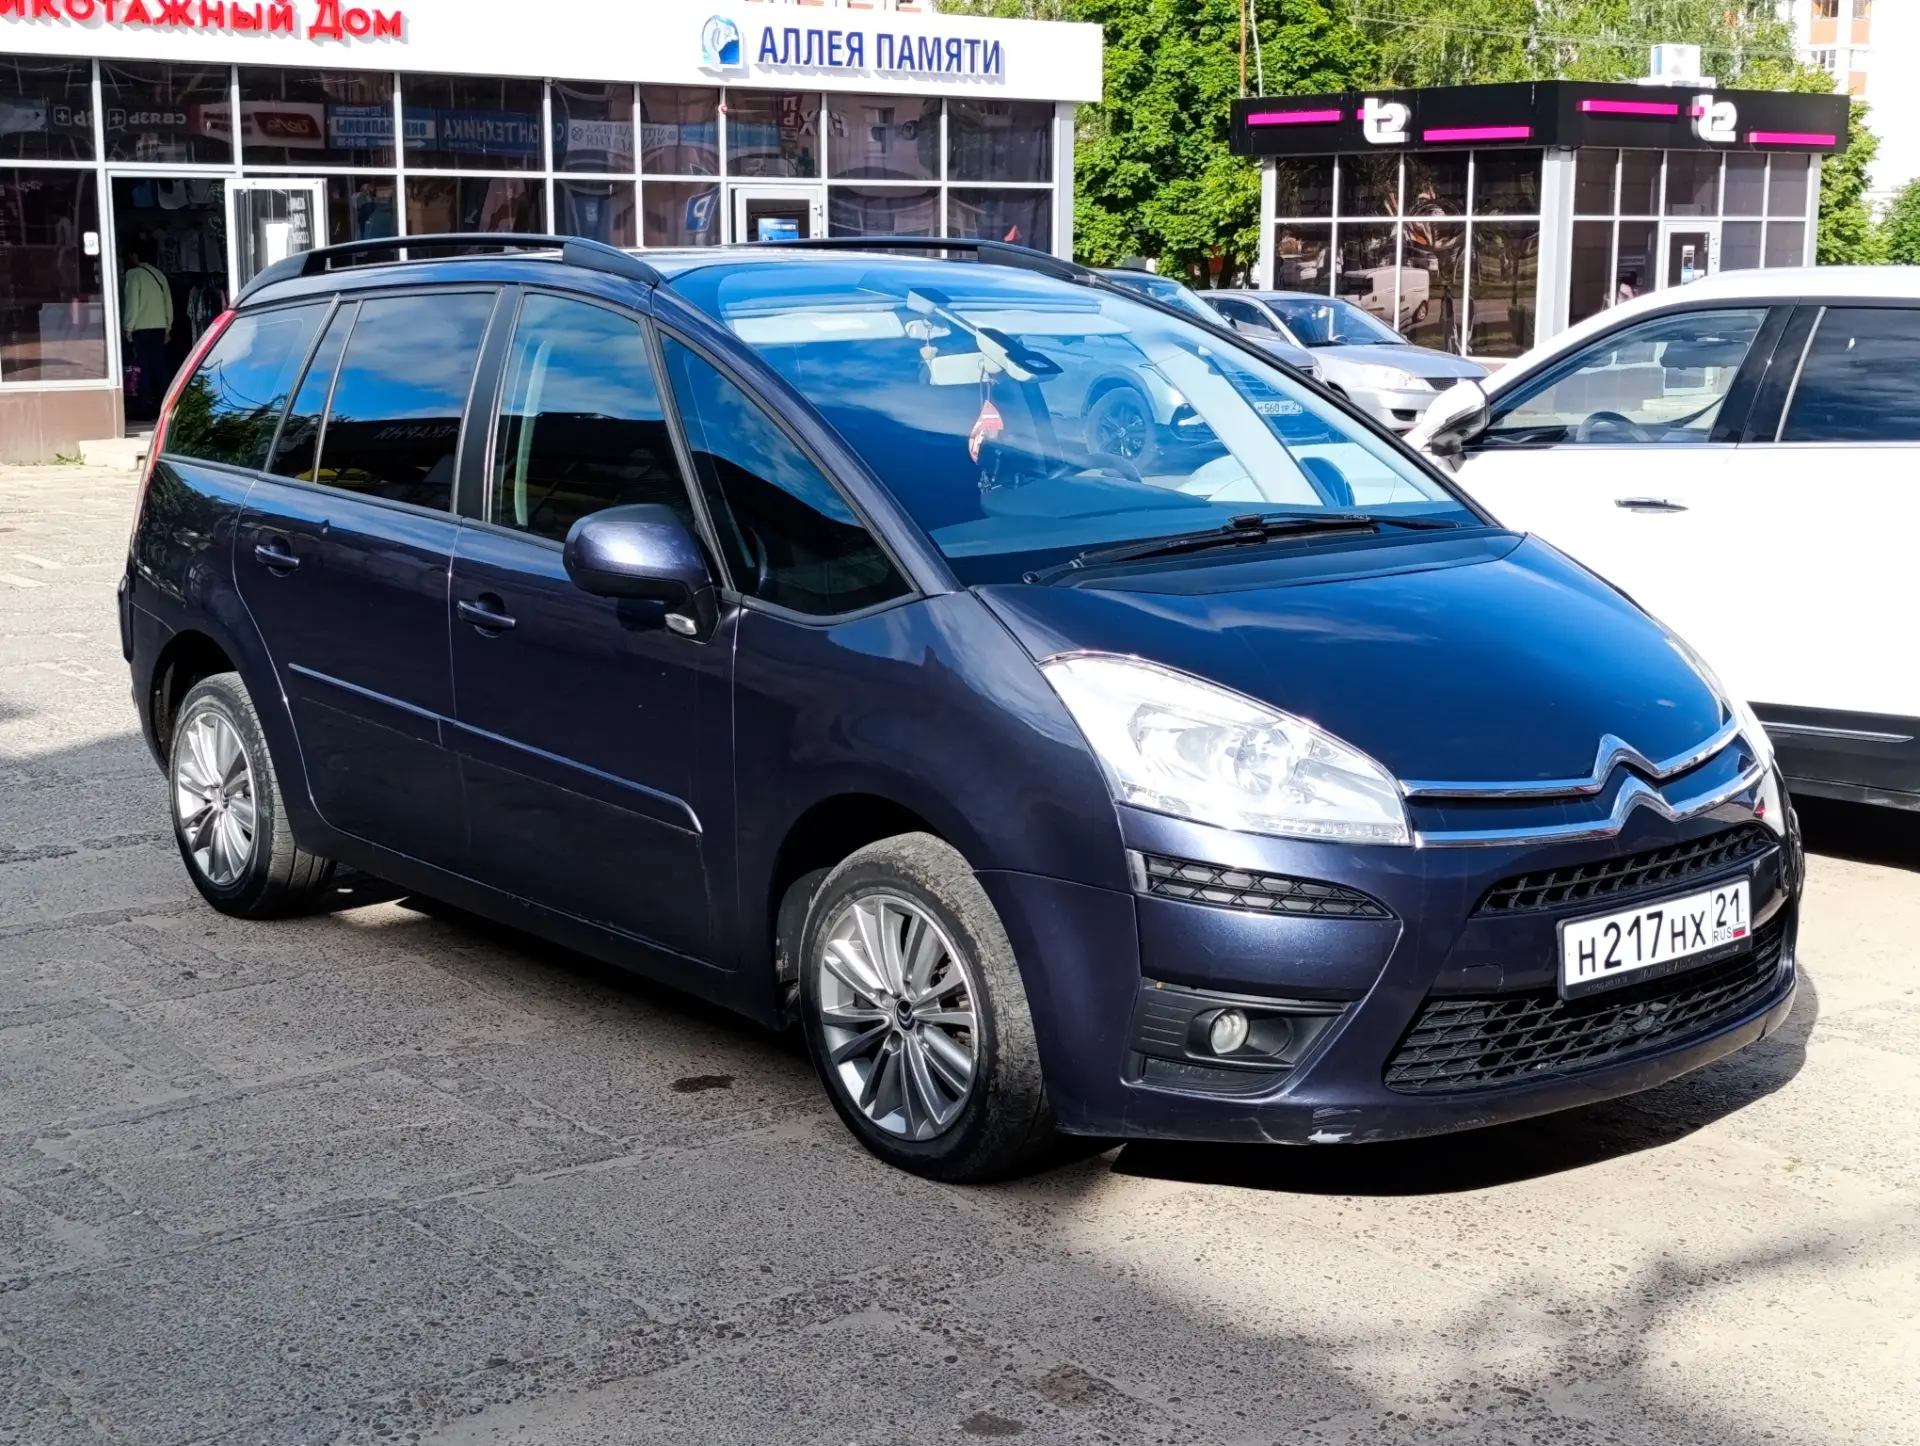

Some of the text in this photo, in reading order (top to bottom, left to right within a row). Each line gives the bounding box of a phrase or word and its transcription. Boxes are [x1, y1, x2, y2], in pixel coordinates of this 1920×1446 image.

[307, 0, 402, 40] Дом
[758, 26, 1000, 75] АЛЛЕЯ ПАМЯТИ
[1578, 888, 1740, 976] Н217НХ 21
[1713, 926, 1733, 943] RUS
